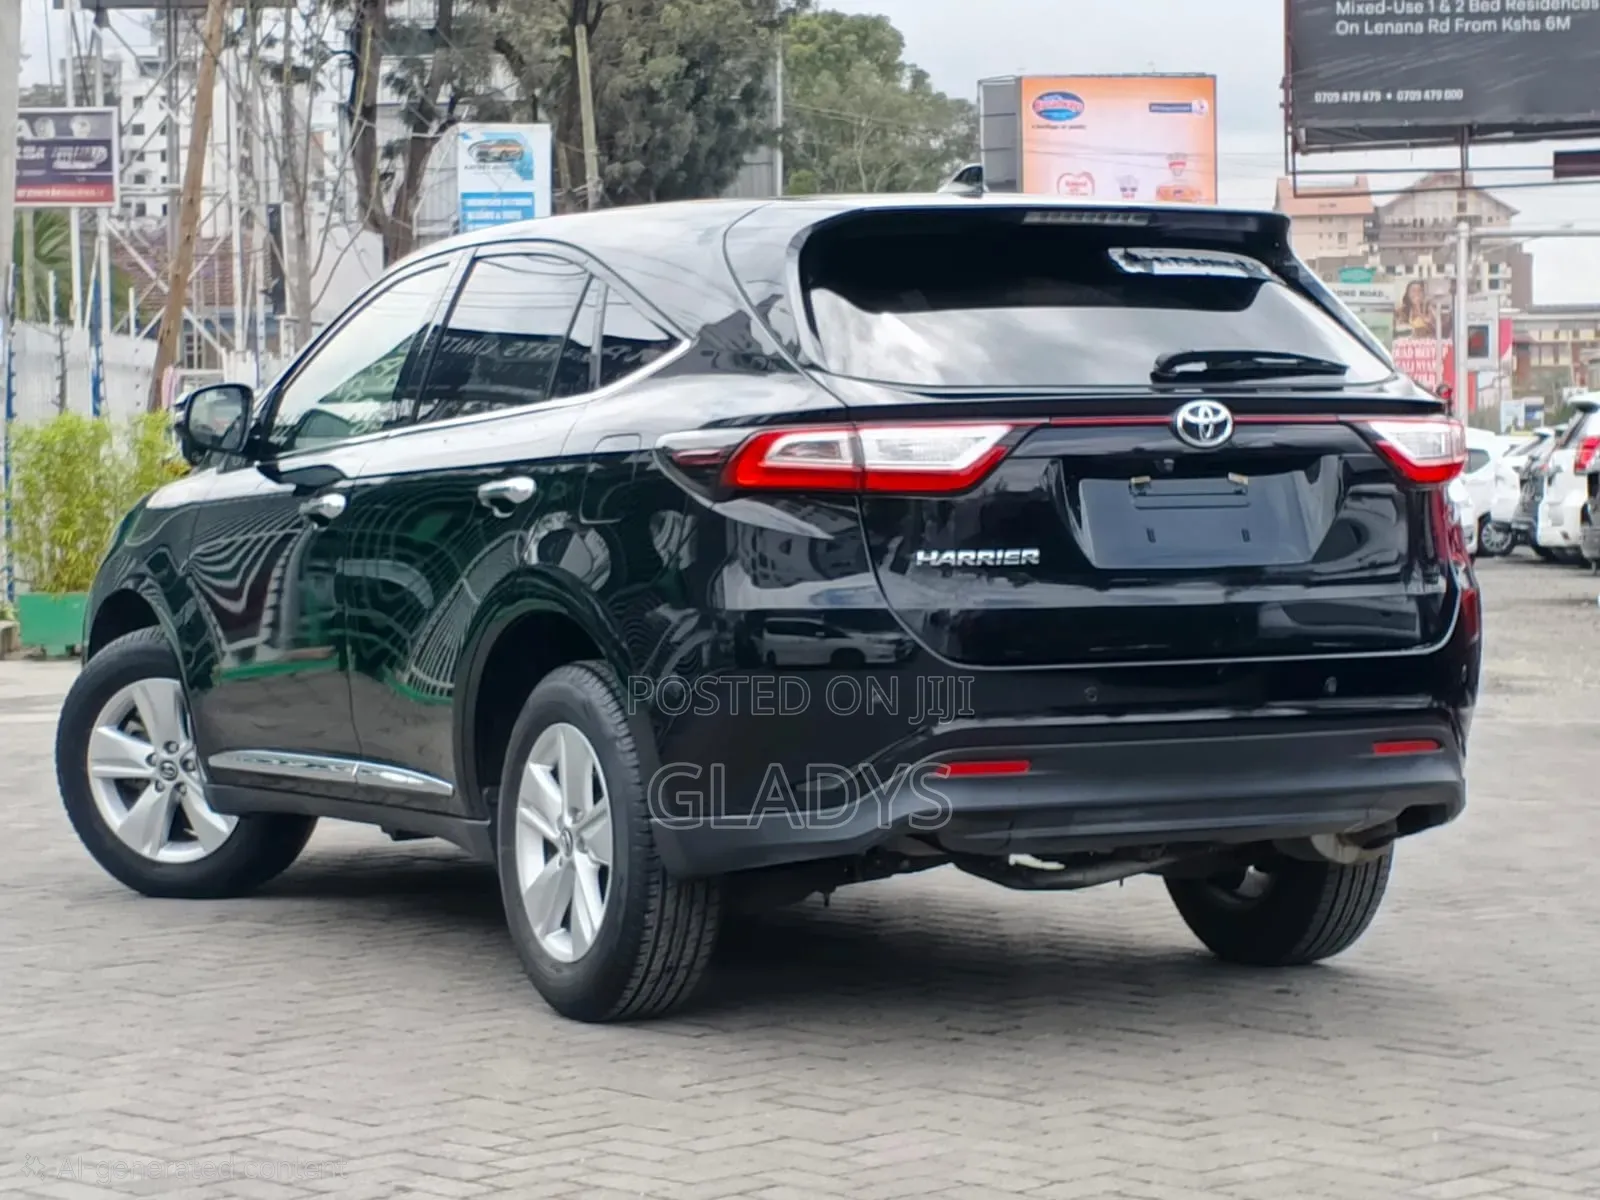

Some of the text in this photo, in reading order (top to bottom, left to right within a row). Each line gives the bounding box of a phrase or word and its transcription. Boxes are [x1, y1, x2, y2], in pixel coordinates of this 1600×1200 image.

[1336, 0, 1424, 15] Mixed-Use
[1427, 0, 1435, 13] 1
[1455, 0, 1465, 13] 2
[1468, 0, 1500, 13] Bed
[1336, 15, 1571, 35] On Lenana Rd From Kshs 6M
[916, 548, 1040, 566] HARRIER
